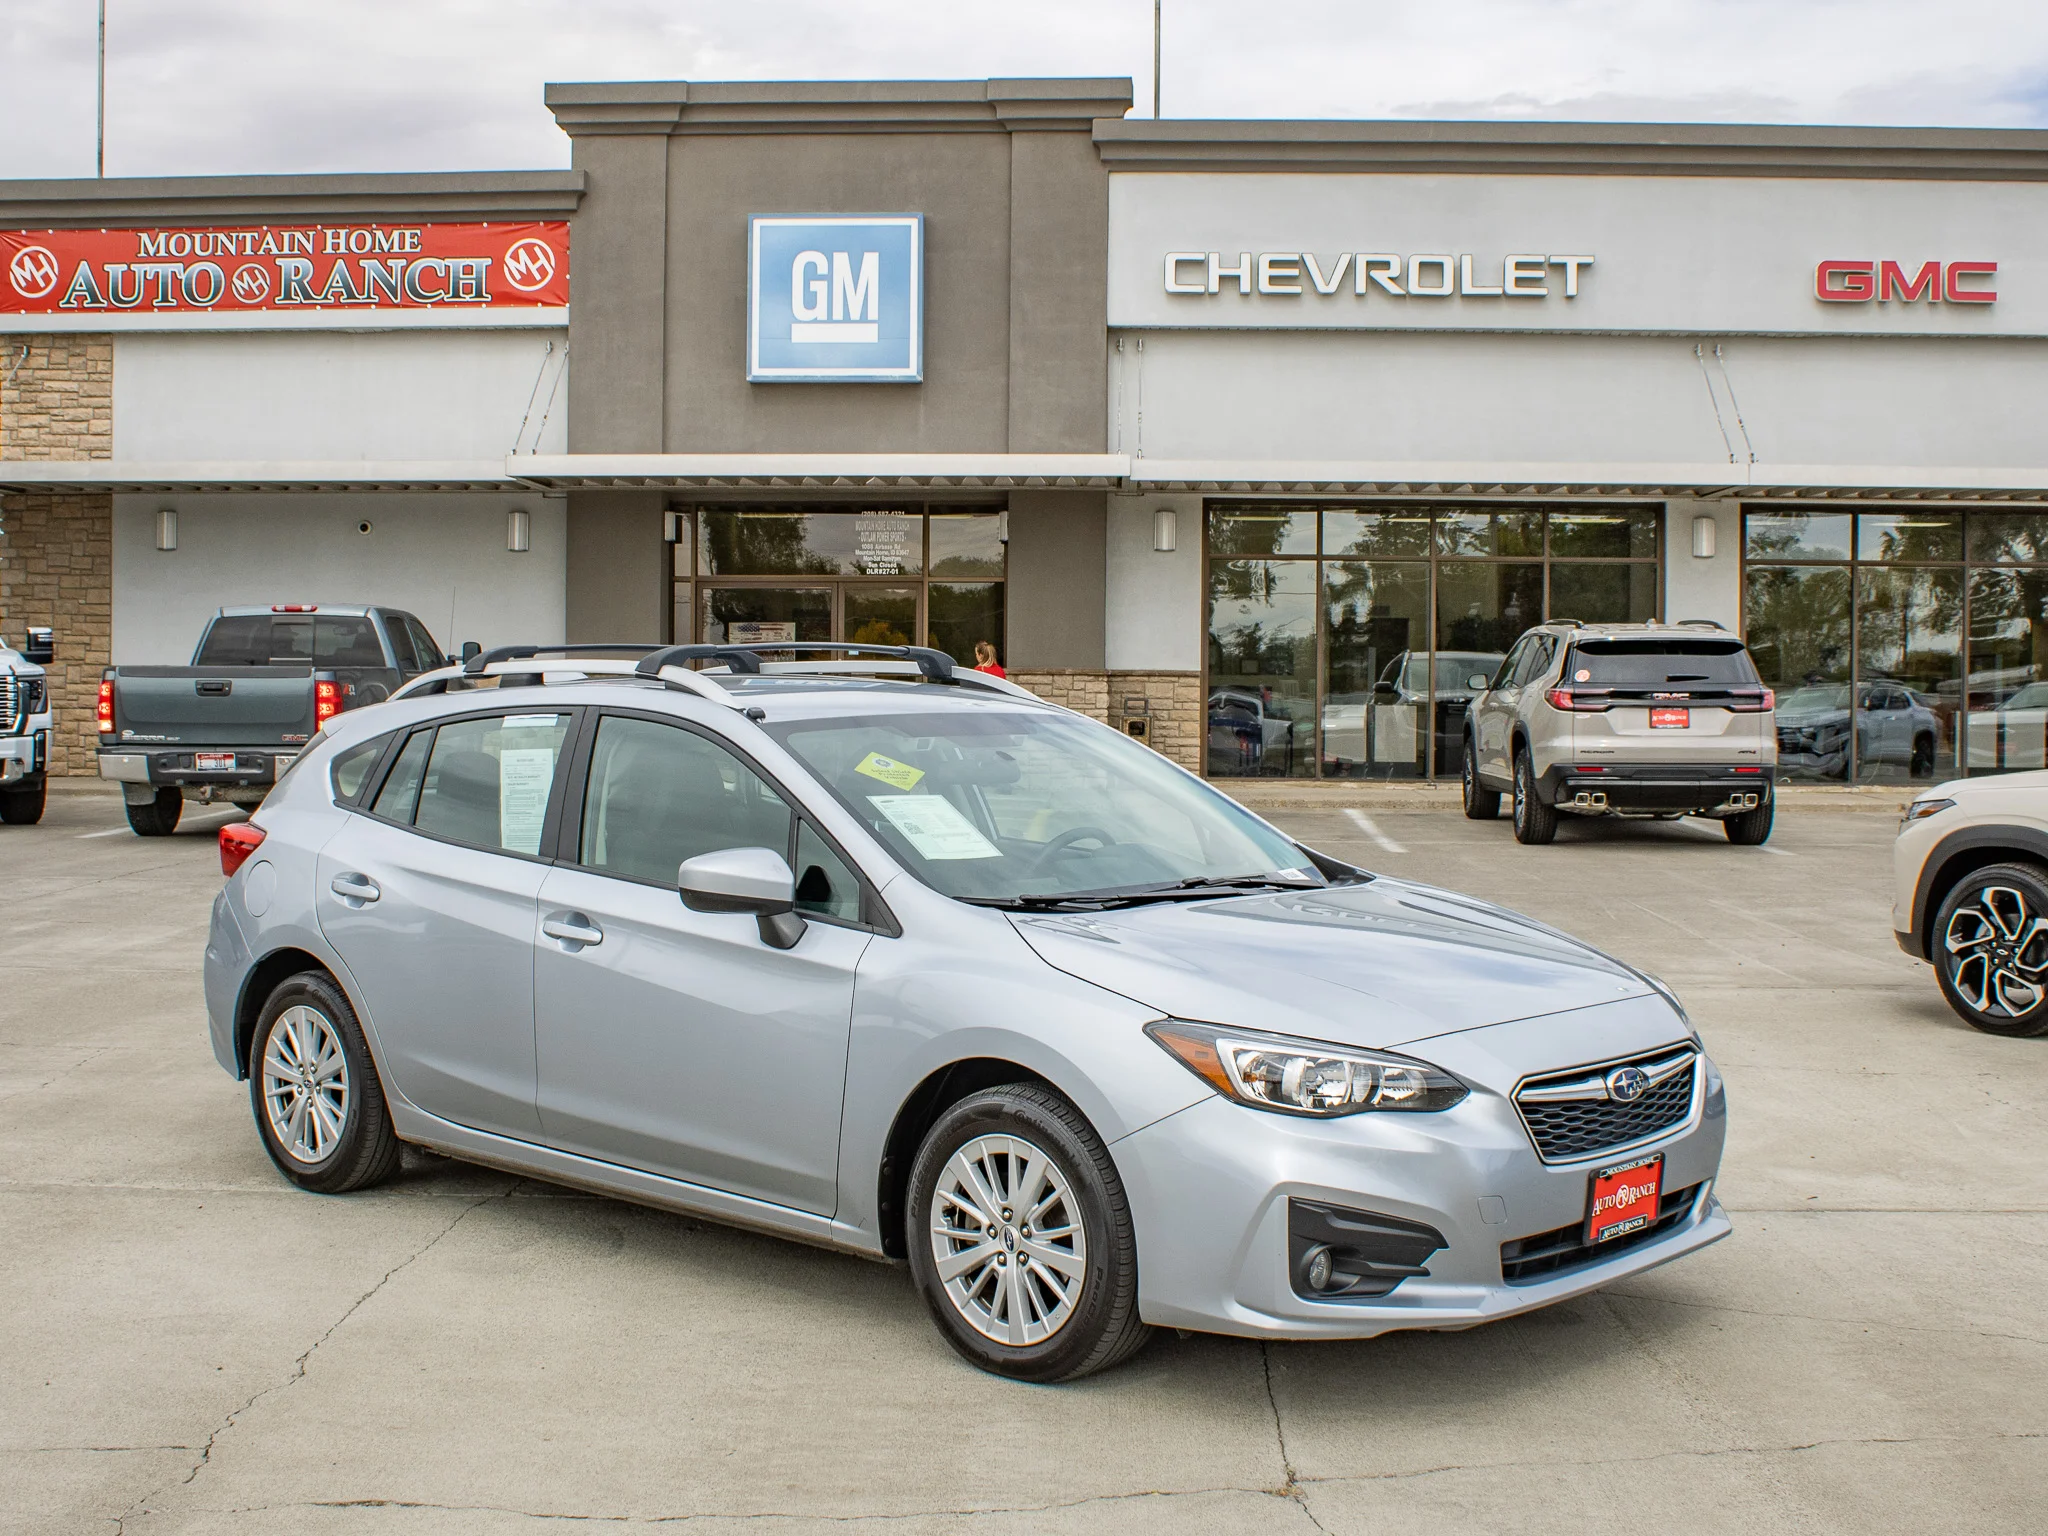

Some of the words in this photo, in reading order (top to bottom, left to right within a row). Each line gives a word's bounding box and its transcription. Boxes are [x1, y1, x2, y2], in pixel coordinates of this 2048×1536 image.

[136, 231, 316, 258] MOUNTAIN
[325, 228, 422, 254] HOME
[59, 260, 226, 308] AUTO
[274, 256, 493, 304] RANCH
[791, 250, 879, 322] GM
[1164, 251, 1596, 297] CHEVROLET
[1814, 260, 1998, 303] GMC
[282, 734, 309, 742] GMC
[1592, 1195, 1616, 1217] AUTO
[1628, 1182, 1656, 1205] RANCH
[1602, 1226, 1619, 1239] AUTO
[1624, 1218, 1644, 1232] RANCH
